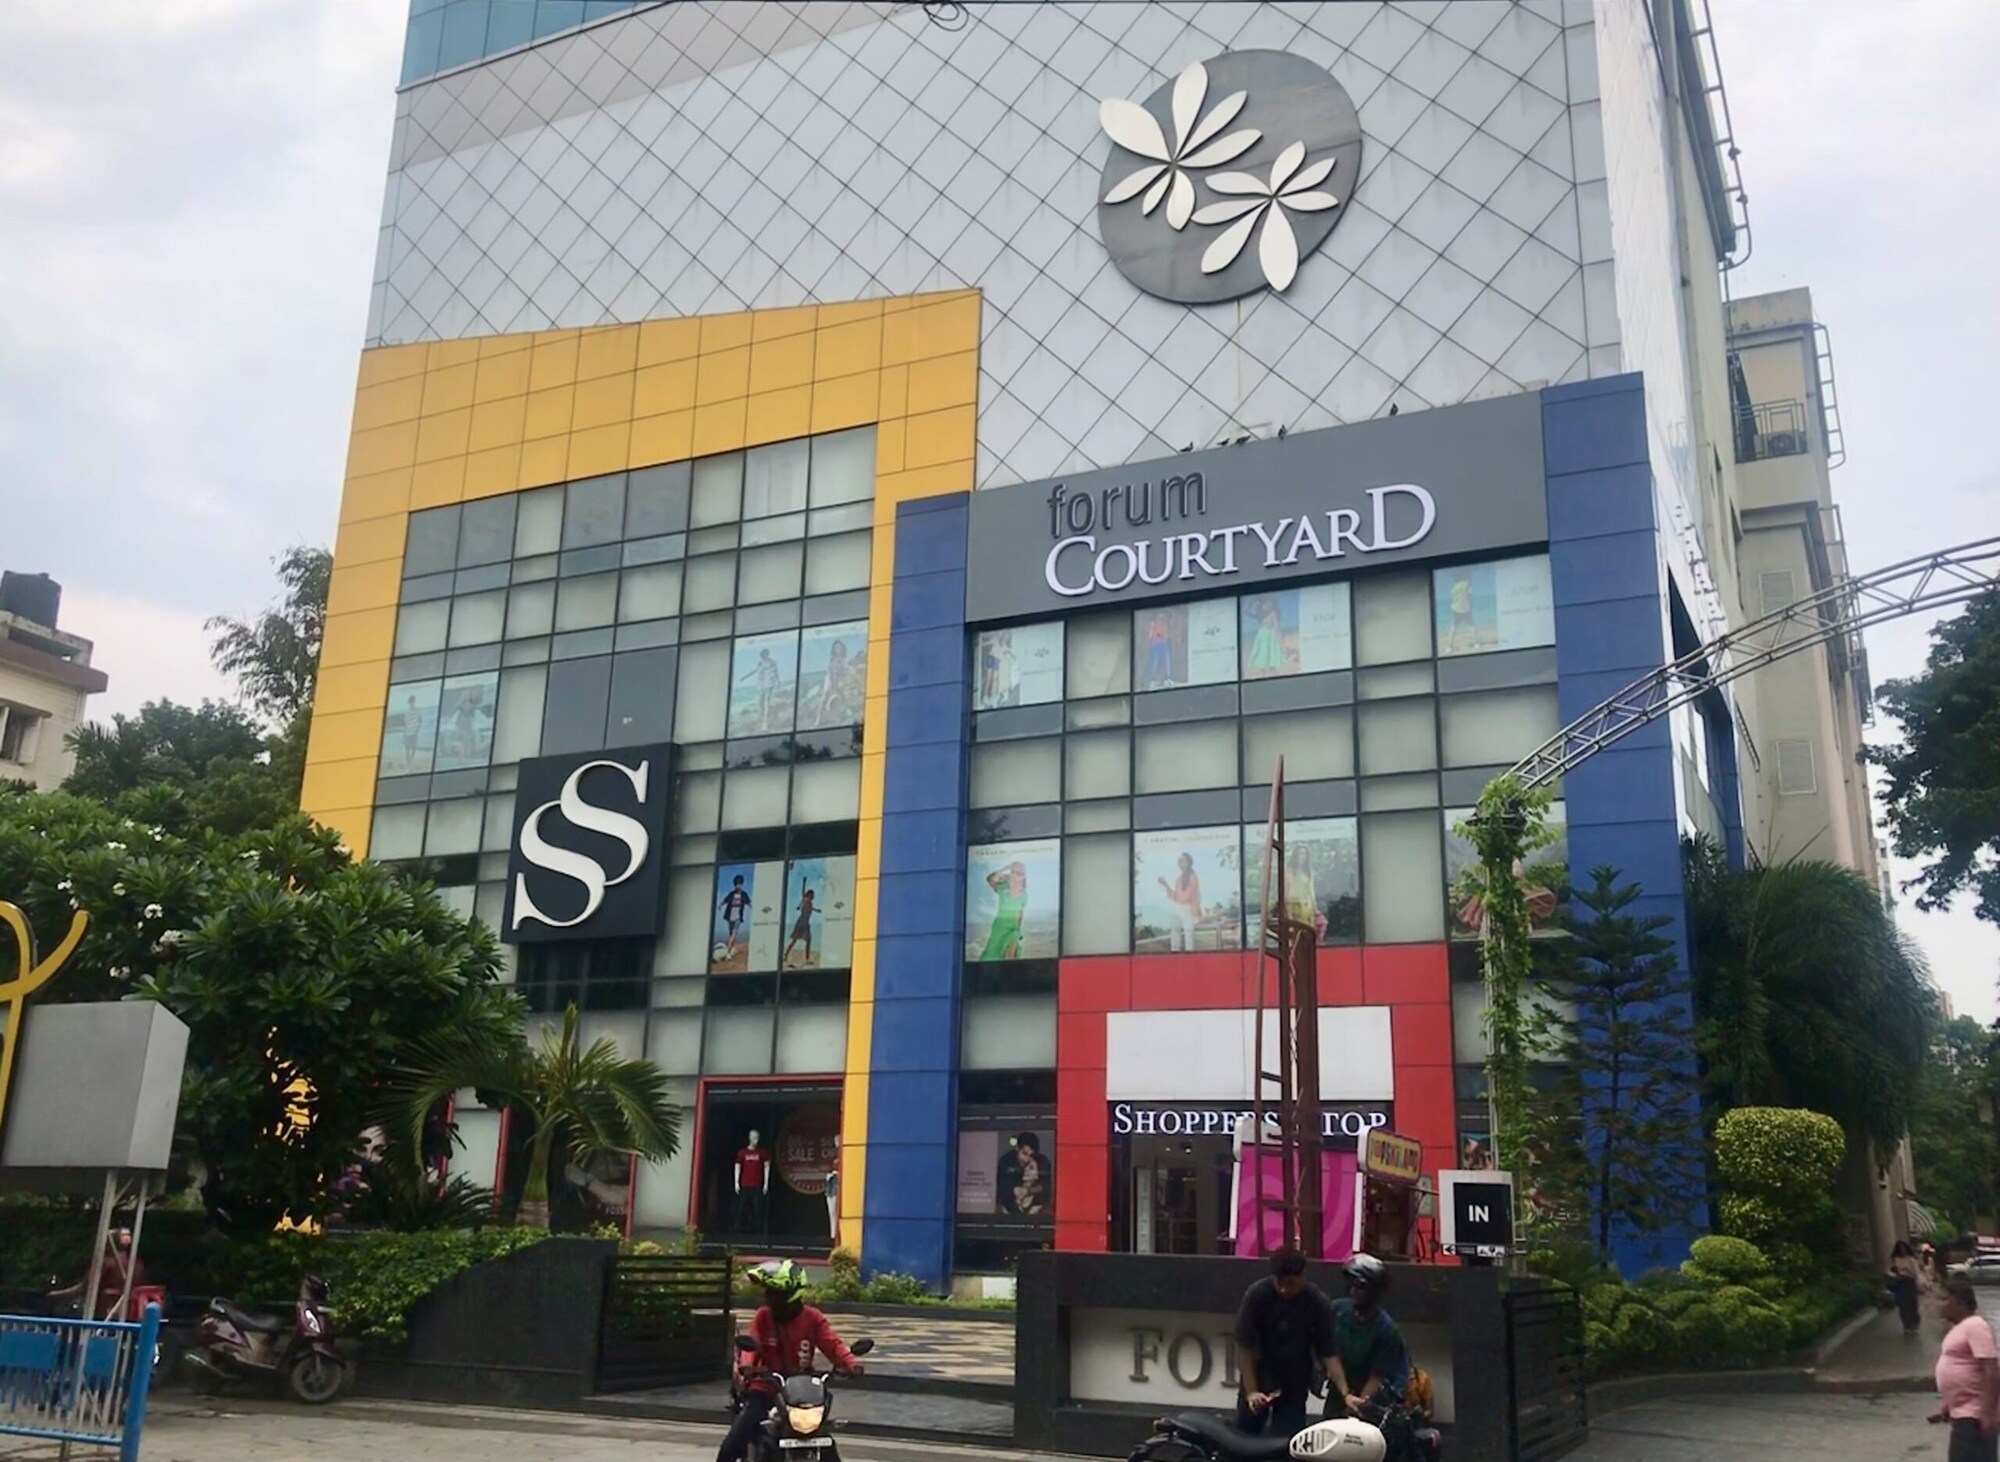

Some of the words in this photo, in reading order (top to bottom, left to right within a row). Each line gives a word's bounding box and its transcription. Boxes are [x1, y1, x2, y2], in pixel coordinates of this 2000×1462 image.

[1047, 471, 1206, 538] forum
[1045, 484, 1437, 596] COURTYARD
[1114, 1103, 1279, 1135] SHOPPES
[1322, 1111, 1387, 1136] TOP
[1468, 1204, 1490, 1223] IN
